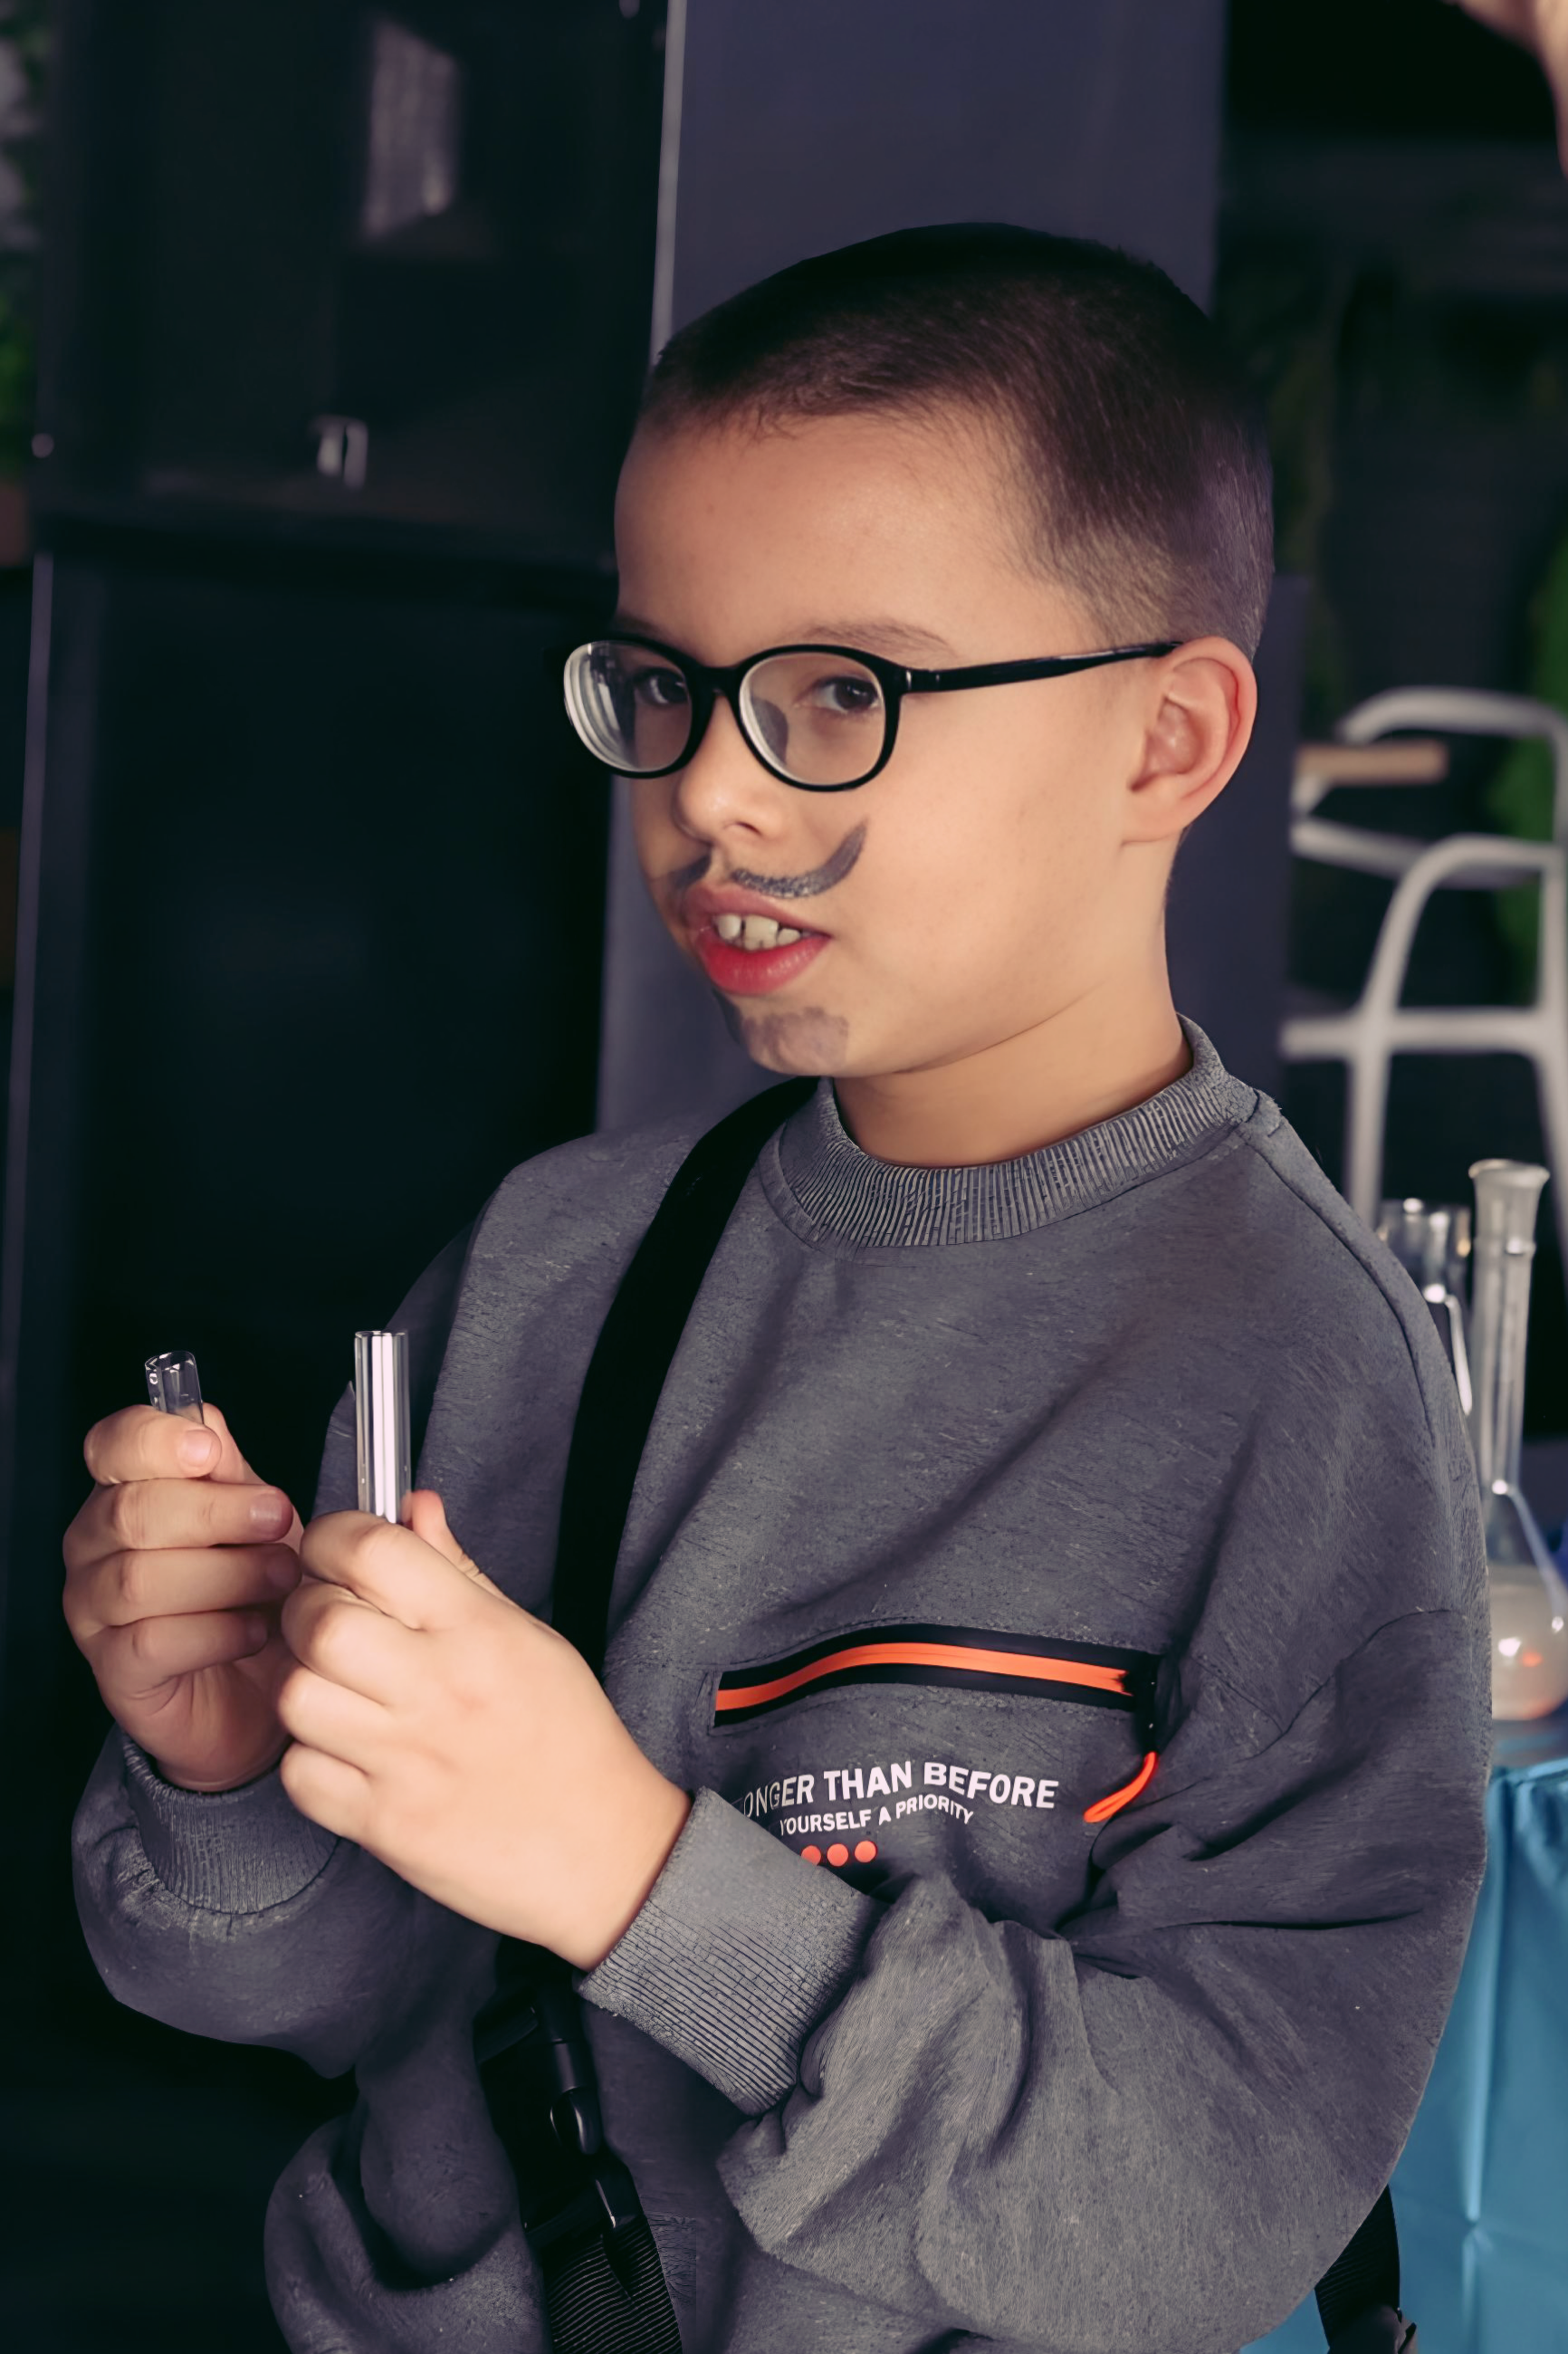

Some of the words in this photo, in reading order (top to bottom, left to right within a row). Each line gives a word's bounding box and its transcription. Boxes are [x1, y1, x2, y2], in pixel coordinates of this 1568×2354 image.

[823, 1761, 913, 1801] THAN
[923, 1762, 1059, 1808] BEFORE
[779, 1809, 872, 1836] YOURSELF
[878, 1806, 892, 1825] A
[895, 1794, 974, 1824] PRIORITY
